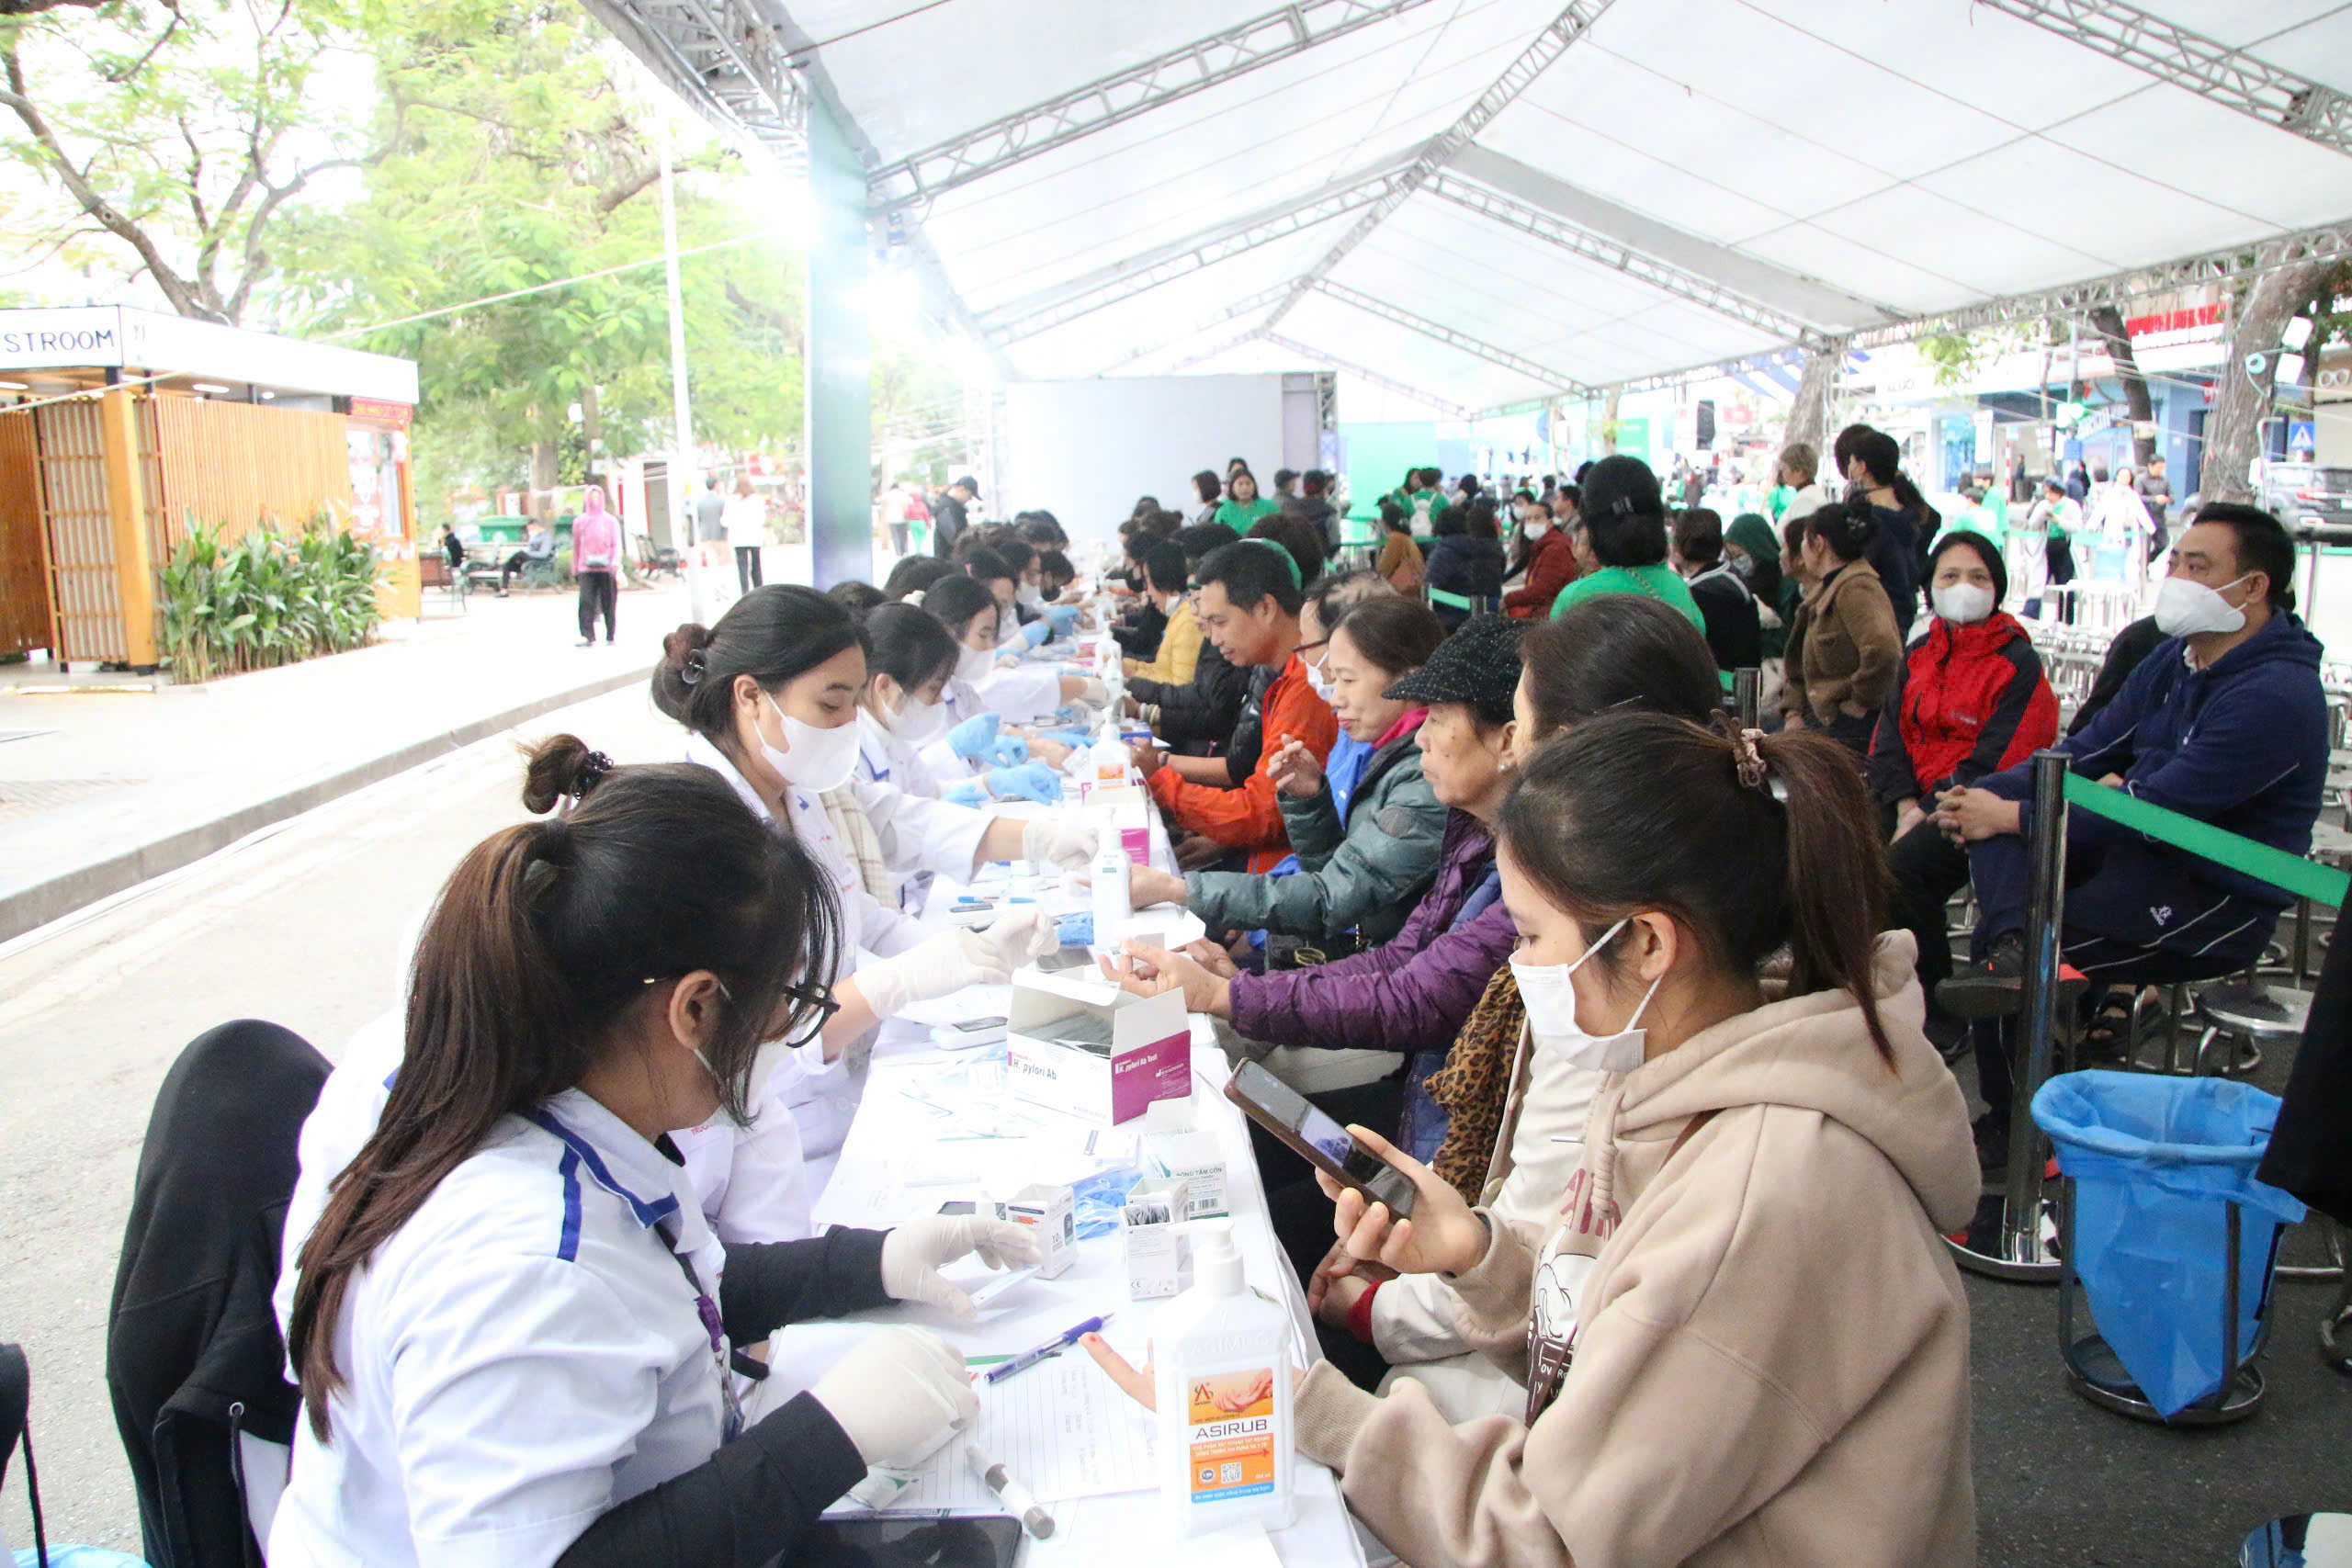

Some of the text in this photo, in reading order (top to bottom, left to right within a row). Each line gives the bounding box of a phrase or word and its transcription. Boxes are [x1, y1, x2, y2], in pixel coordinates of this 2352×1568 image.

[4, 330, 114, 353] STROOM
[1023, 1063, 1046, 1076] pylori
[1195, 1418, 1267, 1439] ASIRUB
